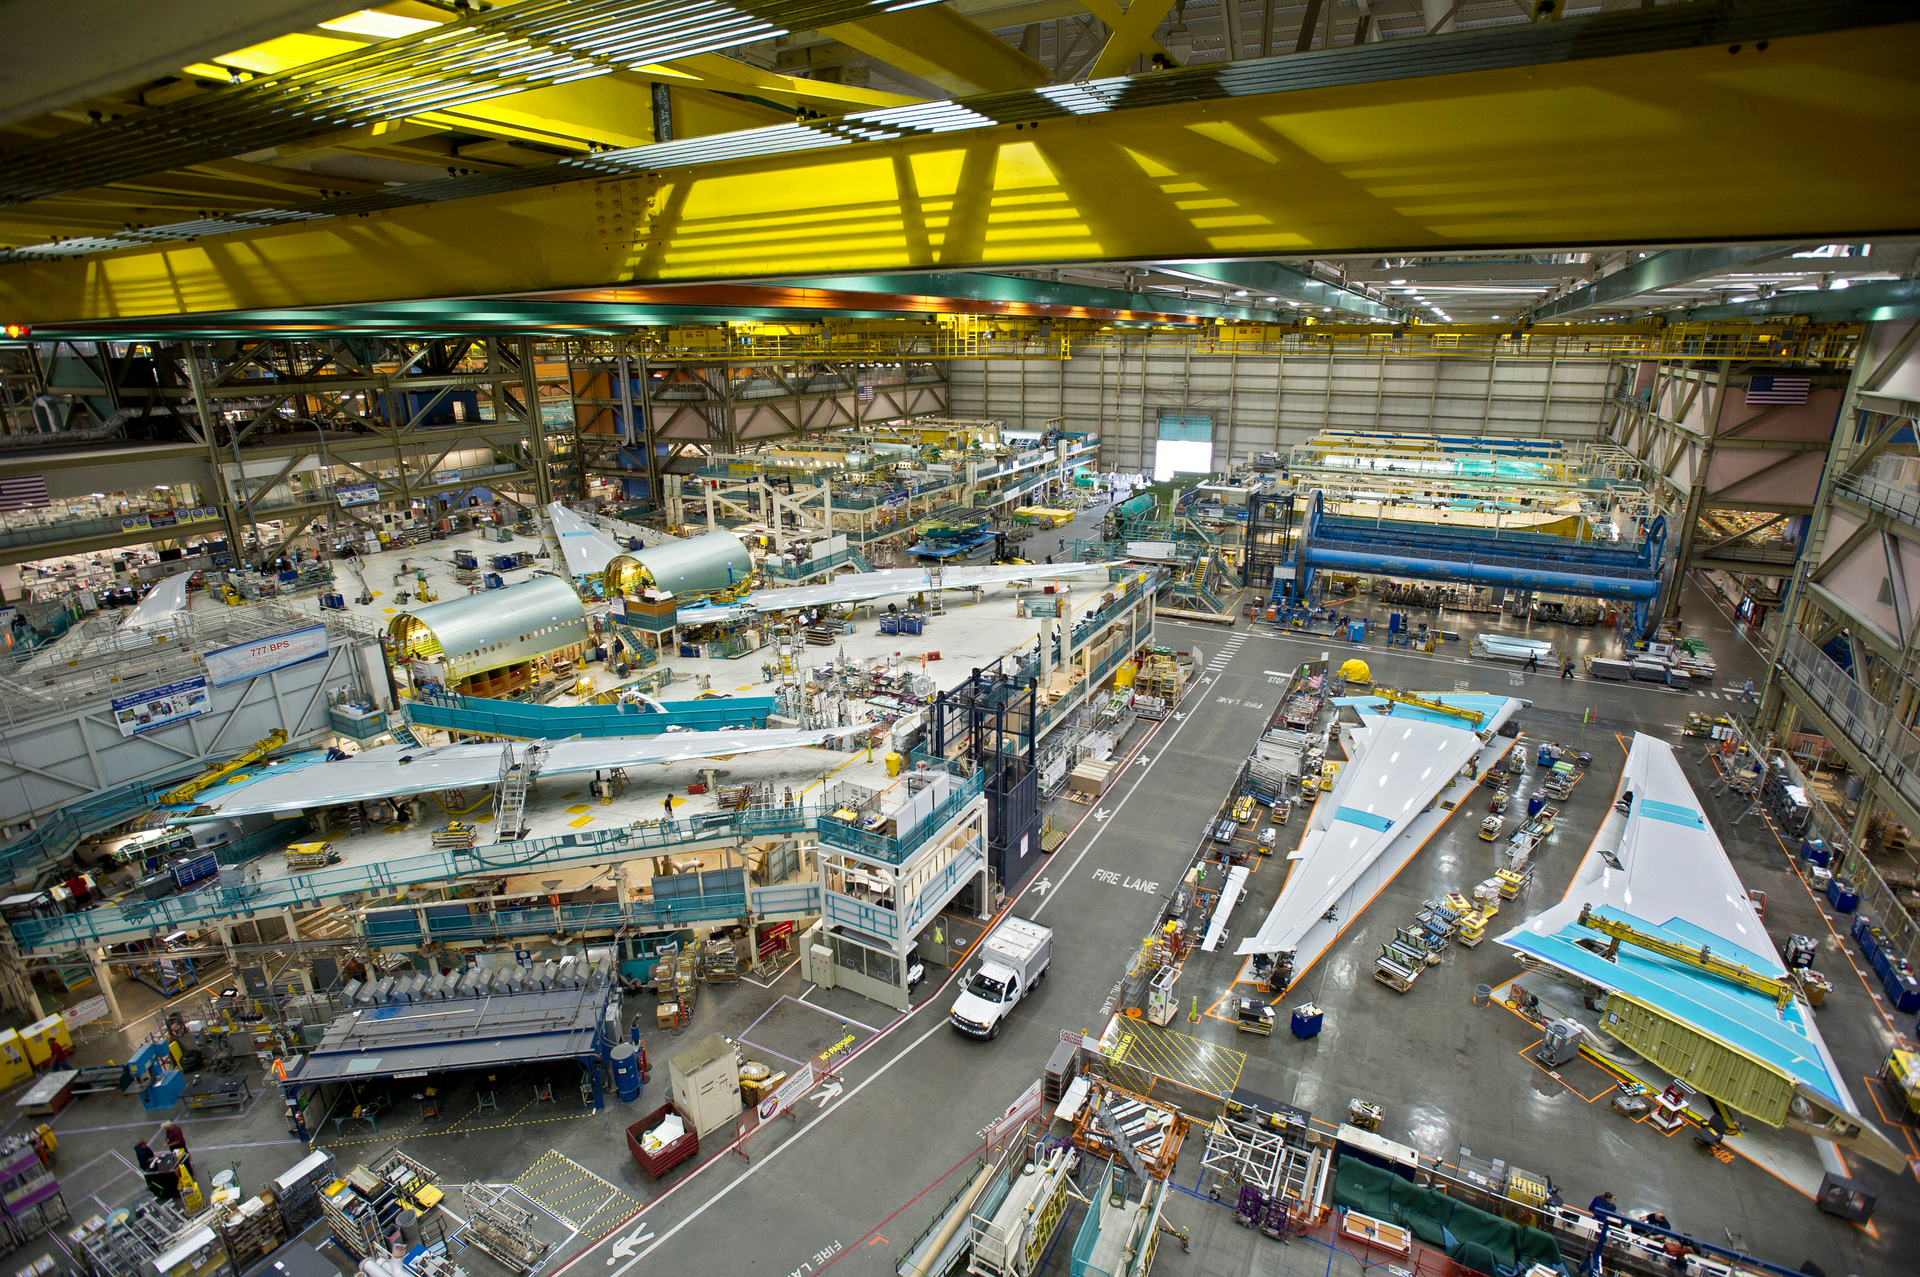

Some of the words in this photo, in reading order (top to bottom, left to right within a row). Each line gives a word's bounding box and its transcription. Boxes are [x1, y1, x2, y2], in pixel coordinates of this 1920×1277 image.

[250, 646, 267, 657] 777
[269, 640, 290, 652] BPS
[184, 676, 204, 684] Together
[1267, 676, 1286, 685] STOP
[1216, 696, 1241, 705] LANE
[1243, 700, 1263, 709] FIRE
[1091, 868, 1122, 885] FIRE
[1122, 876, 1159, 895] LANE
[1098, 996, 1117, 1016] LANE
[819, 1051, 831, 1061] NO
[828, 1034, 856, 1054] PARKING
[813, 1240, 843, 1265] FIRE
[787, 1262, 812, 1277] LA
